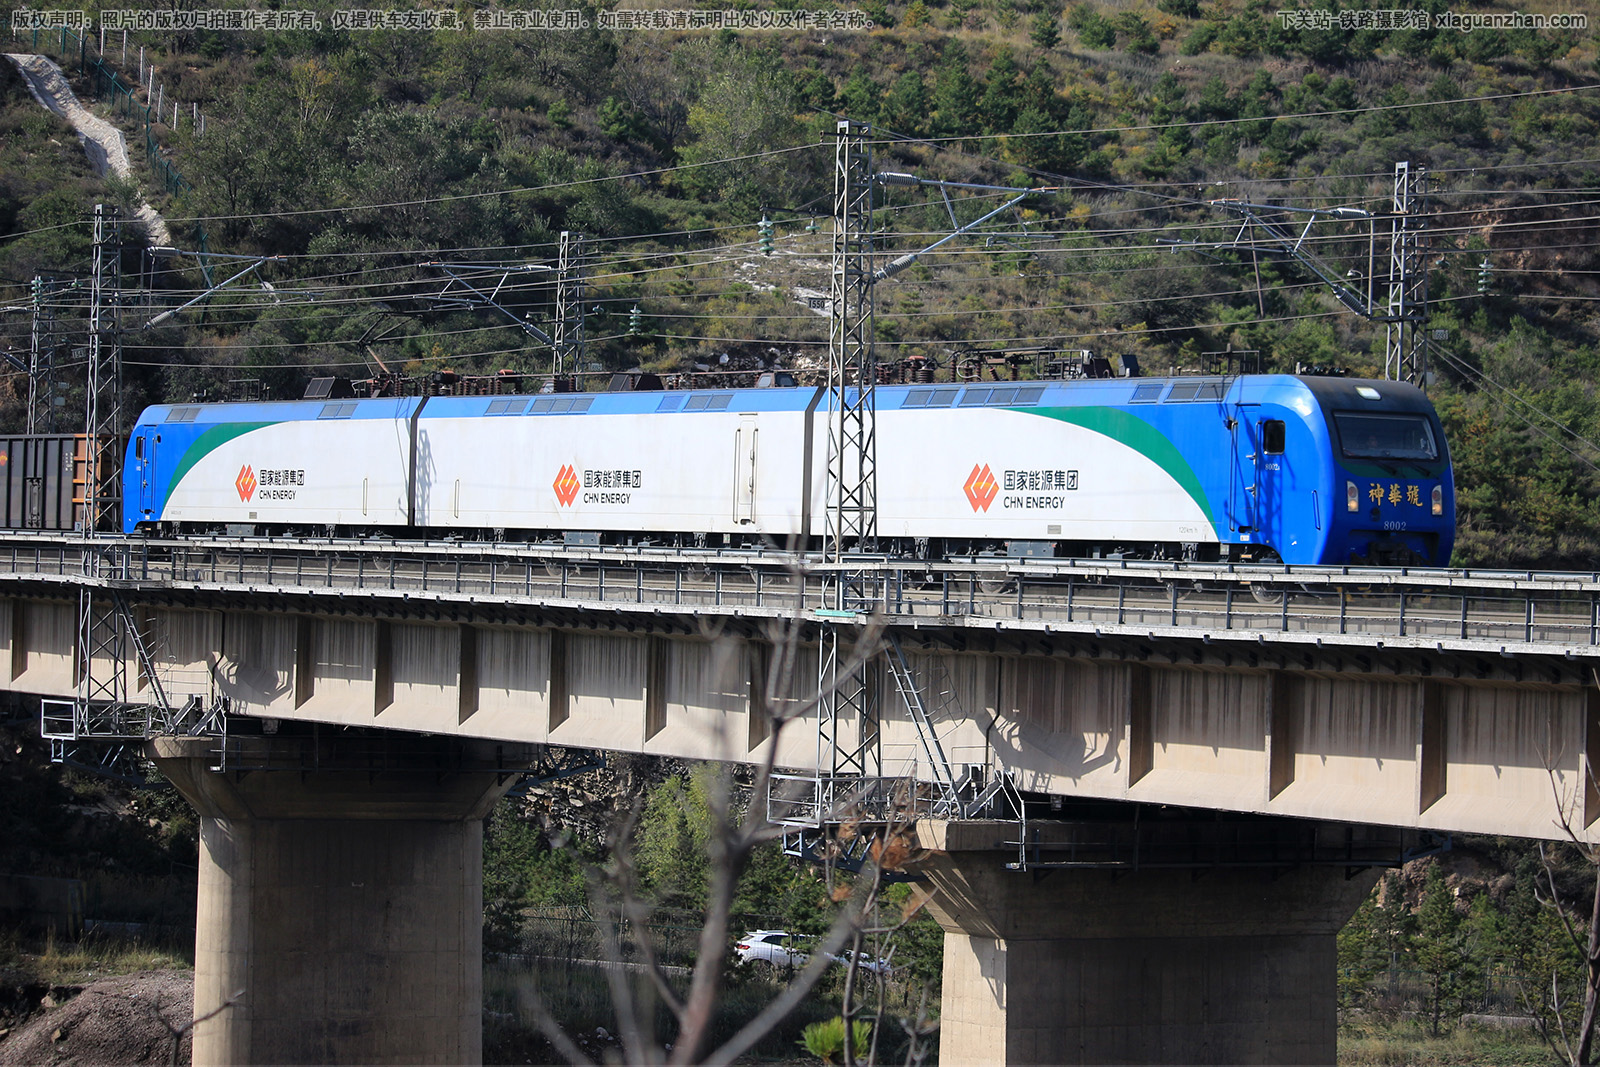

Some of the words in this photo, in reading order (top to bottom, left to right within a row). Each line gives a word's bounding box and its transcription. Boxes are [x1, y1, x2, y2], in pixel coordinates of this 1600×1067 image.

[259, 469, 305, 486] 国家能源集团
[584, 470, 641, 488] 国家能源集团
[1004, 470, 1079, 491] 国家能源集团
[259, 490, 272, 500] CHN
[273, 490, 297, 500] ENERGY
[583, 493, 599, 504] CHN
[601, 493, 631, 504] ENERGY
[1369, 483, 1423, 507] 神華號
[1003, 496, 1023, 509] CHN
[1026, 496, 1065, 510] ENERGY
[1384, 520, 1407, 531] 8002
